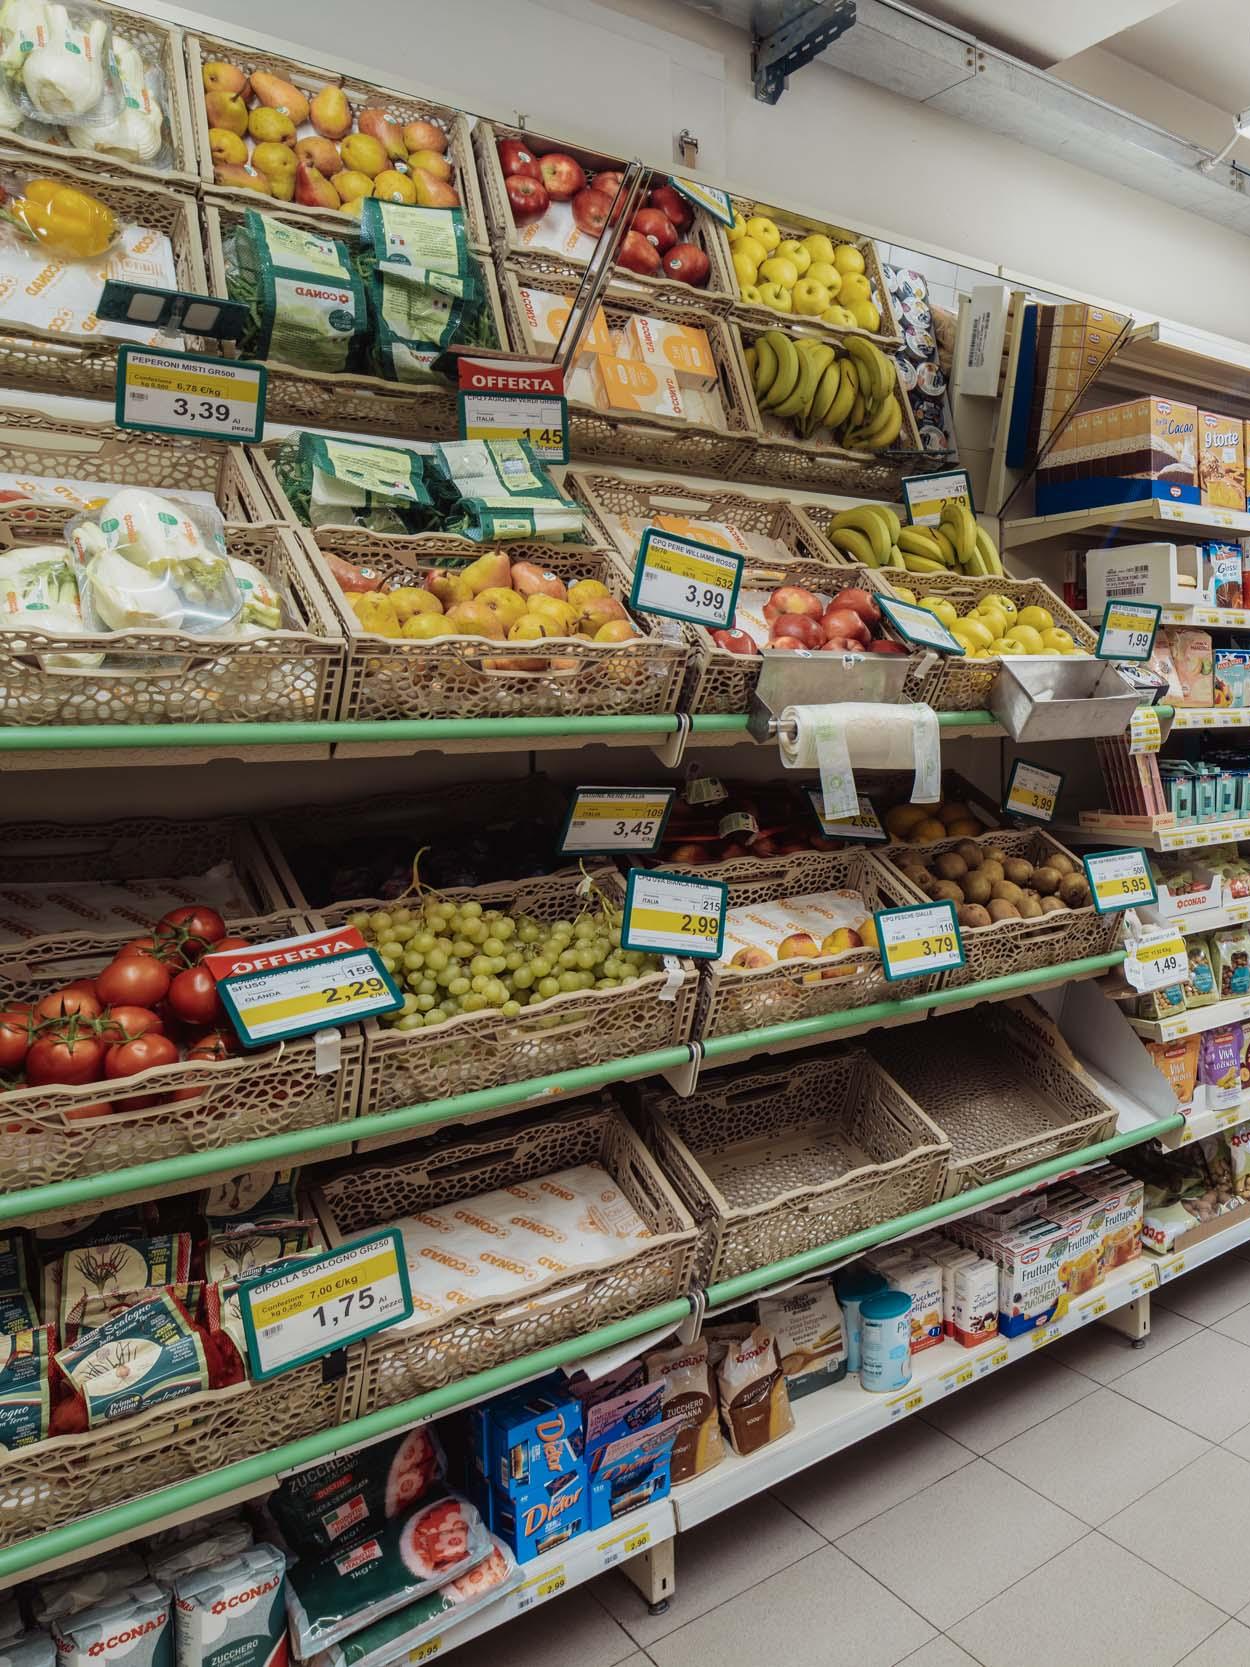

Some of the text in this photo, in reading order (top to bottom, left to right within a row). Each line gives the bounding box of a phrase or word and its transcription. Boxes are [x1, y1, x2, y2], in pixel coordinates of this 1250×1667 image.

[132, 355, 236, 378] PEPERONI MISTI GR500
[176, 382, 221, 397] 6,78 €/kg
[471, 374, 555, 391] OFFERTA
[173, 398, 230, 421] 3,39
[231, 424, 254, 434] pezzo
[1168, 420, 1194, 435] Cacao
[522, 427, 563, 447] 1,45
[1213, 431, 1240, 447] torte
[652, 537, 737, 569] CPQ PERE WILLIAMS ROSSO
[715, 576, 733, 590] 532
[685, 584, 724, 610] 3,99
[1128, 632, 1148, 648] 1,99
[647, 808, 664, 817] 109
[1031, 795, 1052, 812] 3,99
[613, 821, 655, 838] 3,45
[849, 816, 878, 829] 2,65
[1122, 878, 1146, 895] 5,95
[703, 901, 720, 912] 215
[1184, 896, 1207, 907] CONAD
[681, 914, 719, 936] 2,99
[894, 912, 914, 921] PESCHE
[940, 922, 954, 932] 110
[922, 936, 953, 957] 3,79
[231, 940, 353, 975] OFFERTA
[1154, 956, 1177, 974] 1,49
[231, 965, 375, 993] SFUSO 159
[244, 990, 281, 1003] OLANDA
[321, 977, 384, 1004] 2,29
[1218, 1048, 1235, 1060] VIVA
[454, 1210, 498, 1235] CONAD
[511, 1215, 556, 1238] CONAD
[254, 1239, 389, 1295] CIPOLLA SCALOGNO GR250
[420, 1247, 467, 1272] CONAD
[479, 1252, 525, 1276] CONAD
[310, 1275, 359, 1300] 7,00 €/kg
[262, 1294, 304, 1313] Confezione
[312, 1286, 375, 1328] 1,75
[379, 1298, 403, 1313] pezzo
[911, 1297, 942, 1313] elificante
[105, 1304, 151, 1336] Scalogno
[271, 1309, 281, 1318] kg
[141, 1385, 191, 1409] Scalogno
[667, 1398, 703, 1417] ZUCCHERO
[521, 1487, 583, 1537] Dietor
[630, 1537, 647, 1551] 2,90
[227, 1576, 280, 1608] CONAD
[547, 1581, 565, 1594] 2,99
[106, 1613, 167, 1649] CONAD
[211, 1640, 258, 1665] ZUCCHERO
[418, 1645, 438, 1660] 2,95
